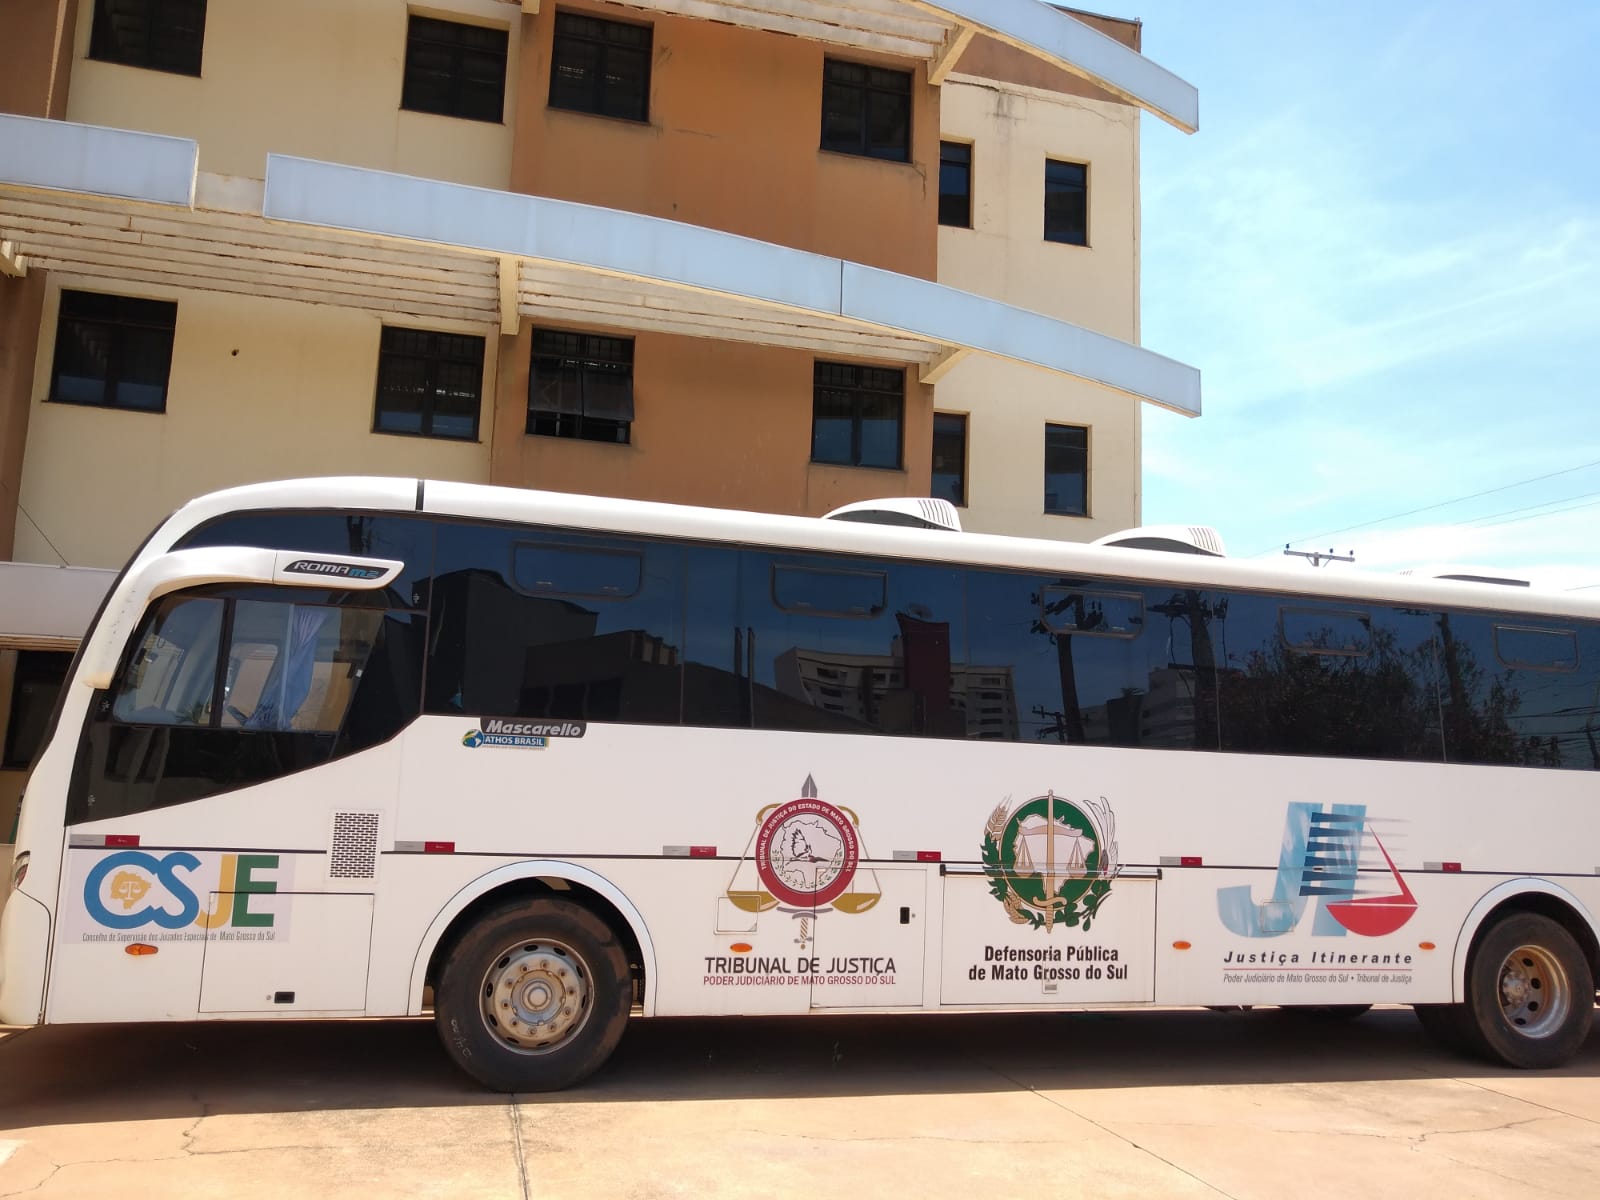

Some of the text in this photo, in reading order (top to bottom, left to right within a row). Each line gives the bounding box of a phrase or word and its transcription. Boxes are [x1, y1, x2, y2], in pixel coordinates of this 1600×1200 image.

[294, 562, 349, 574] ROMA
[486, 720, 580, 736] Mascarello
[485, 736, 544, 747] ATHOS BRASIL
[787, 805, 798, 813] DO
[821, 806, 831, 814] DE
[83, 850, 280, 930] CSJE
[984, 946, 1119, 962] Defensoria Pública
[1223, 951, 1413, 966] Justiça Itinerante
[704, 957, 897, 977] TRIBUNAL DE JUSTIÇA
[968, 964, 1129, 980] de Mato Grosso do Sul
[703, 975, 734, 986] PODER
[787, 975, 799, 985] DE
[801, 975, 825, 985] MATO
[827, 975, 863, 985] GROSSO
[865, 975, 878, 985] DO
[879, 975, 896, 985] SUL
[1223, 973, 1412, 985] Poder Judiciário de Mato Grosso do Sul Tribunal de Justiça
